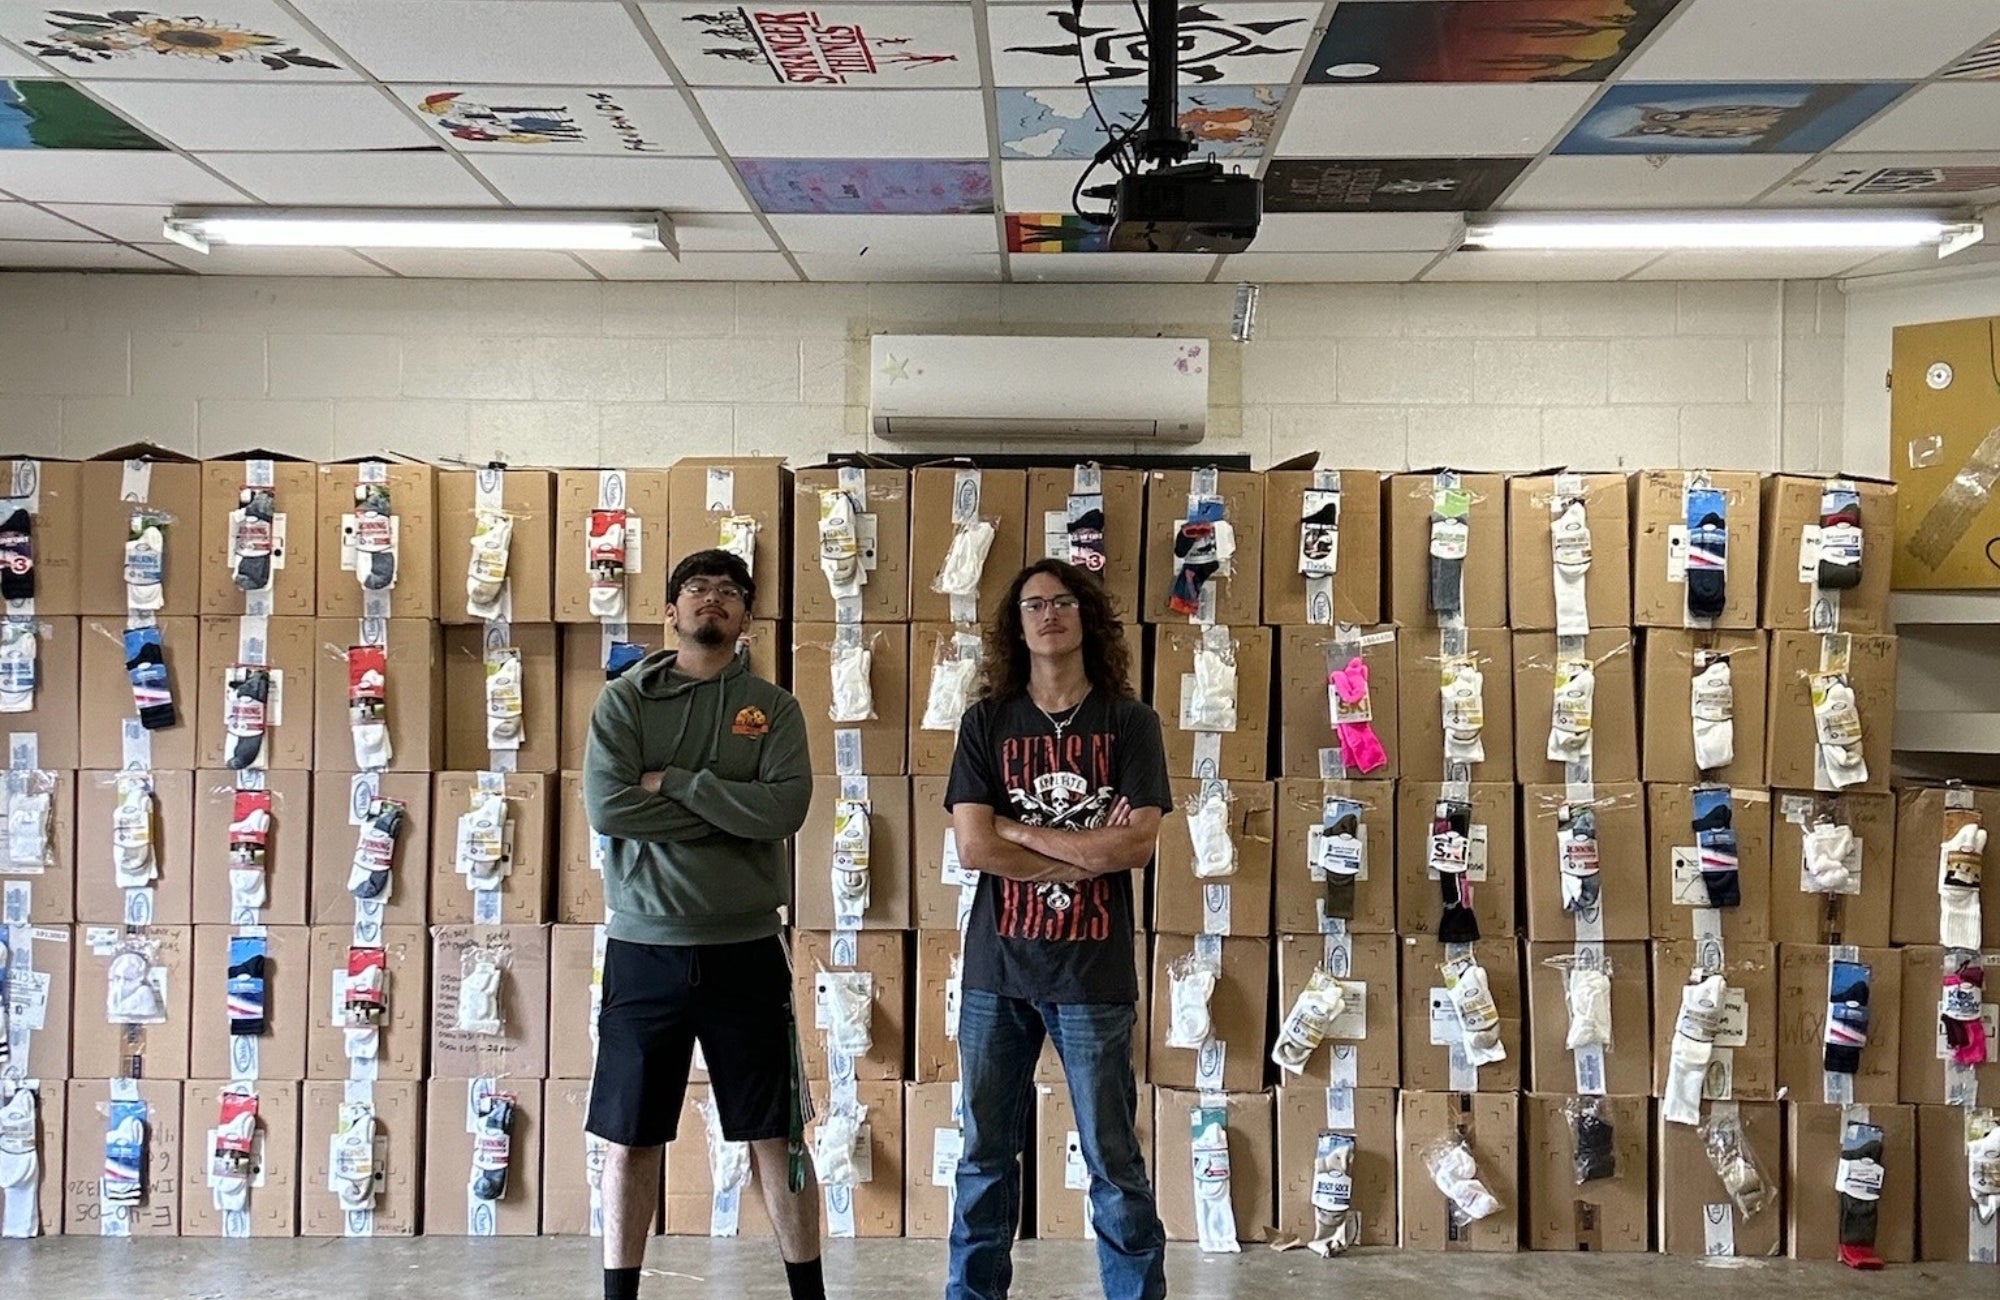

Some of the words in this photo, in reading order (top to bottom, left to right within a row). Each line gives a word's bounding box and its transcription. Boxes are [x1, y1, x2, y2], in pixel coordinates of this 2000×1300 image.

[753, 11, 838, 84] STRANGER
[810, 25, 871, 75] THINGS
[13, 559, 27, 571] 3
[1088, 554, 1101, 569] 3
[1002, 733, 1083, 793] GUNS
[1038, 773, 1084, 791] APPETITE
[996, 877, 1111, 942] ROSES
[1948, 990, 1975, 1001] KIDS
[76, 1202, 173, 1227] E-40-05
